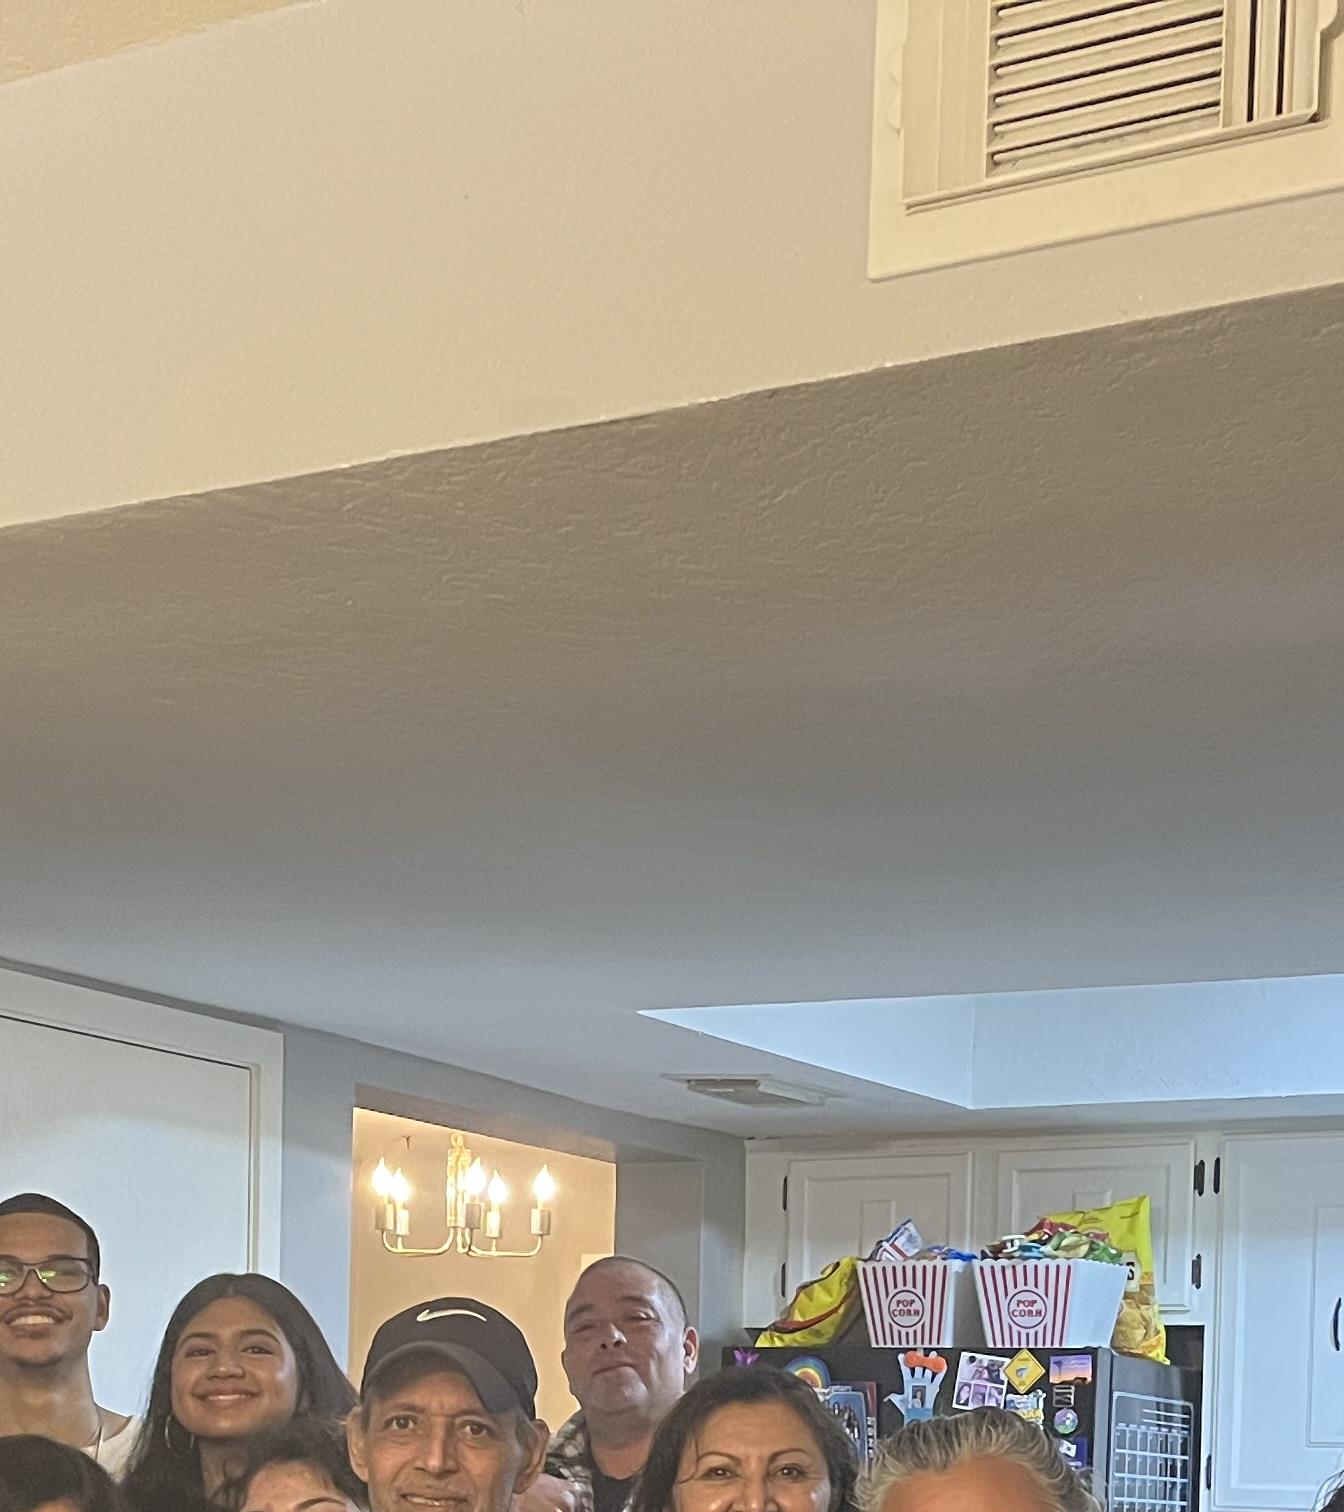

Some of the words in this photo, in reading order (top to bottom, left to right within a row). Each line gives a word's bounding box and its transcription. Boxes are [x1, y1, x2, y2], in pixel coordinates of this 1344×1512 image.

[896, 1299, 915, 1308] POP
[1017, 1299, 1038, 1308] POP
[892, 1308, 920, 1318] CORN
[1012, 1308, 1042, 1318] CORN
